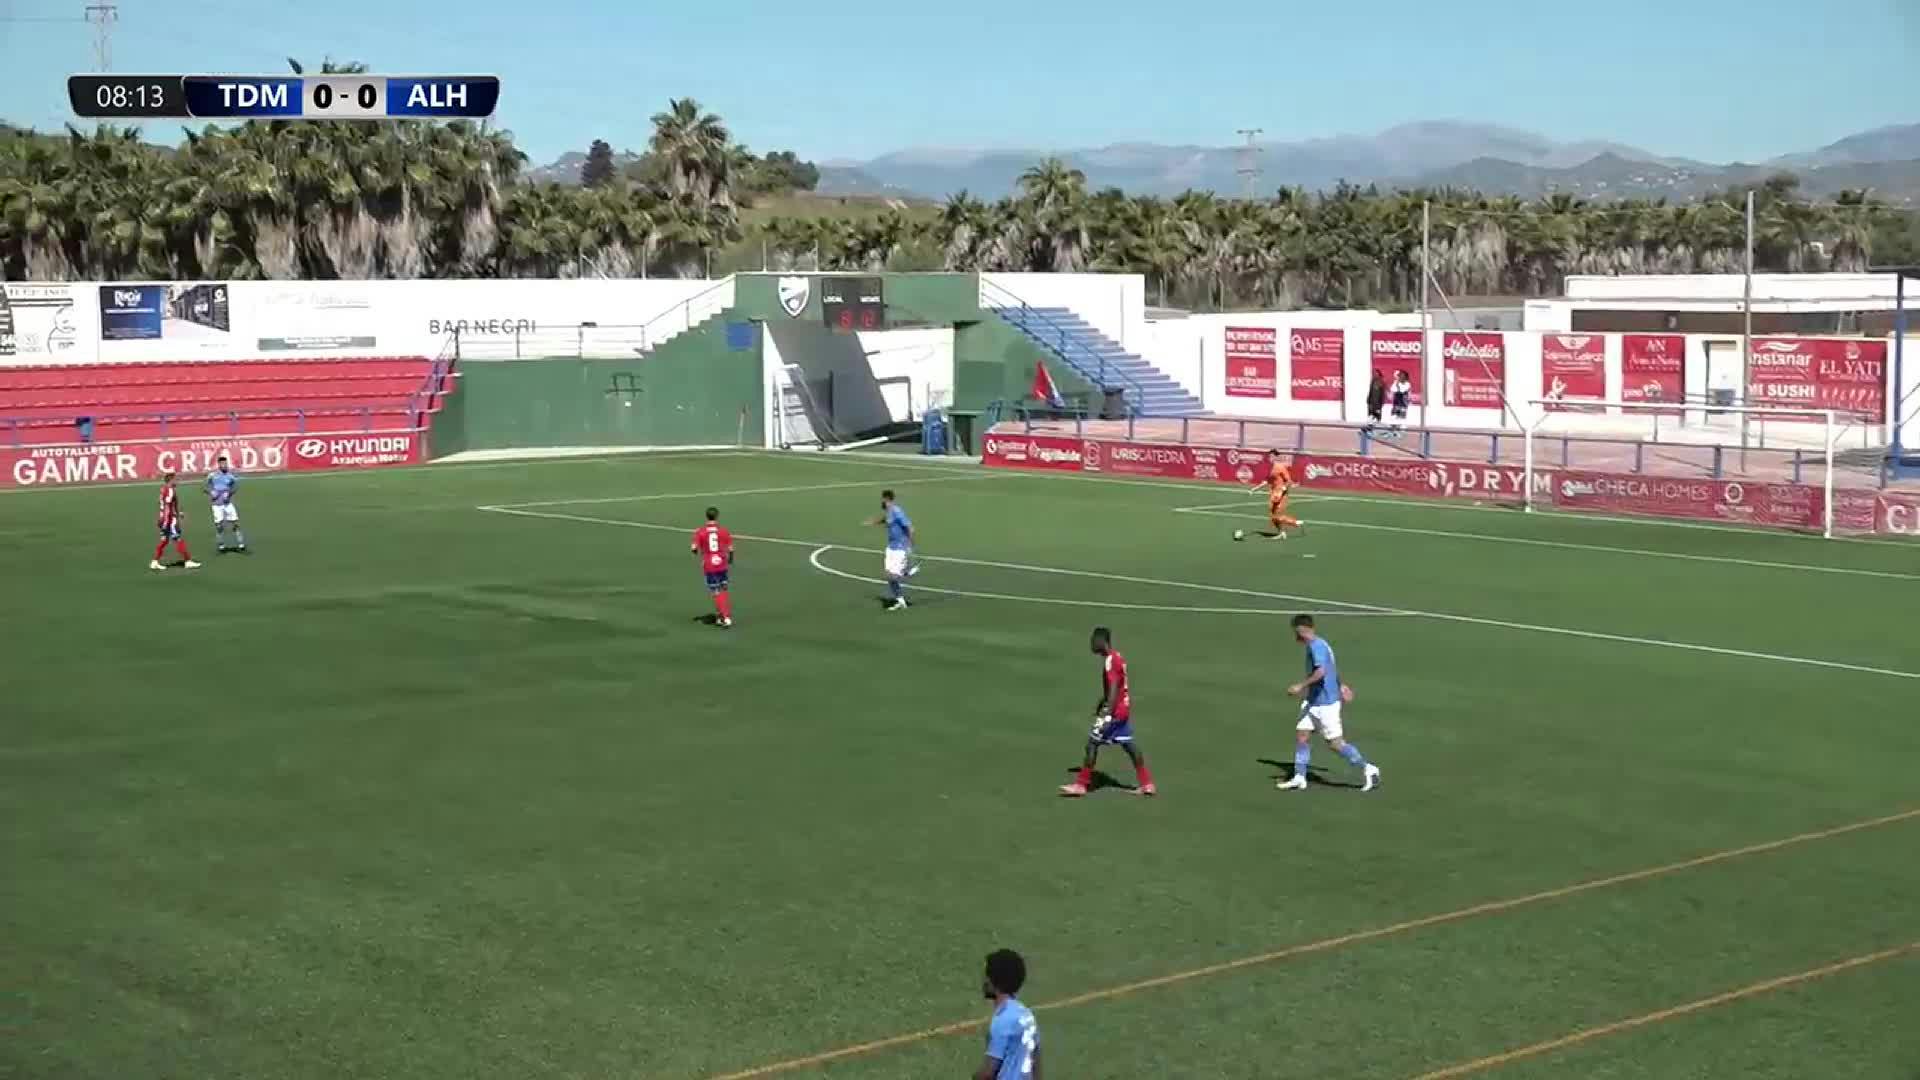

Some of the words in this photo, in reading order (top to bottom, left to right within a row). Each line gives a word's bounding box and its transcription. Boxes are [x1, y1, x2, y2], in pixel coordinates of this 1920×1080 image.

[1768, 384, 1816, 398] SUSHI
[330, 437, 410, 454] HYUNDAI
[14, 453, 137, 485] GAMAR
[158, 447, 281, 473] CRIADO
[709, 532, 718, 552] 6
